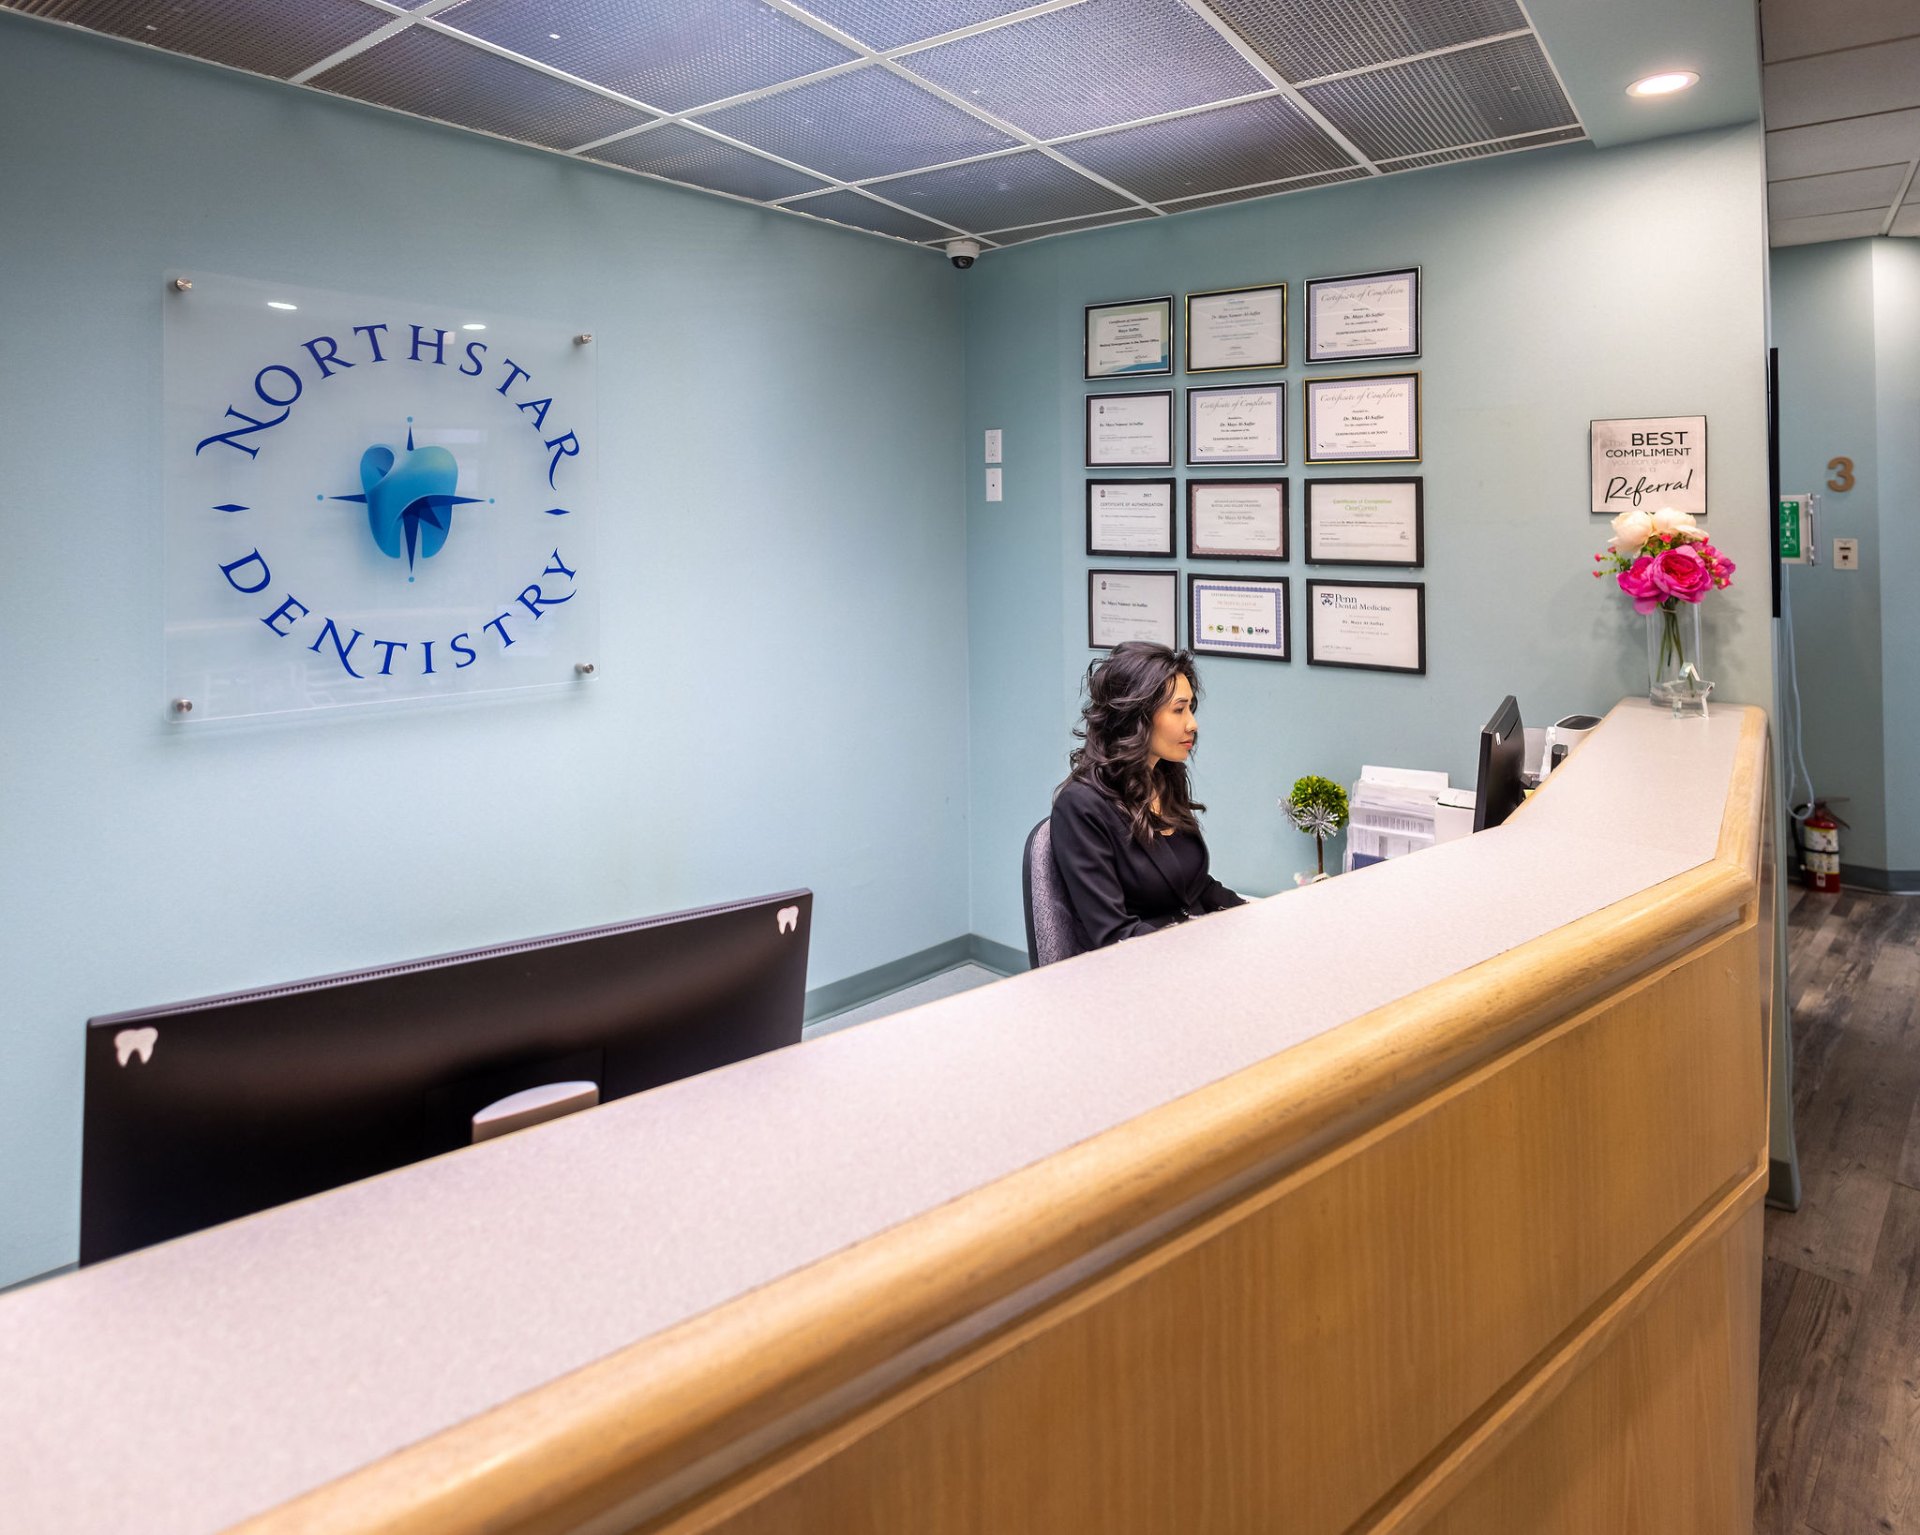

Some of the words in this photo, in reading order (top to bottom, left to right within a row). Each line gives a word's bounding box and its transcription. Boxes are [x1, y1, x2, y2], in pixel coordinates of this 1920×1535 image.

[195, 323, 580, 490] NORTHSTAR
[1631, 431, 1689, 447] BEST
[1605, 447, 1692, 458] COMPLIMENT
[1604, 468, 1694, 507] Referral
[1826, 456, 1855, 493] 3
[1334, 592, 1357, 604] Penn
[1334, 601, 1358, 610] Dental
[1358, 603, 1392, 612] Medicine
[217, 546, 577, 679] DENTISTRY
